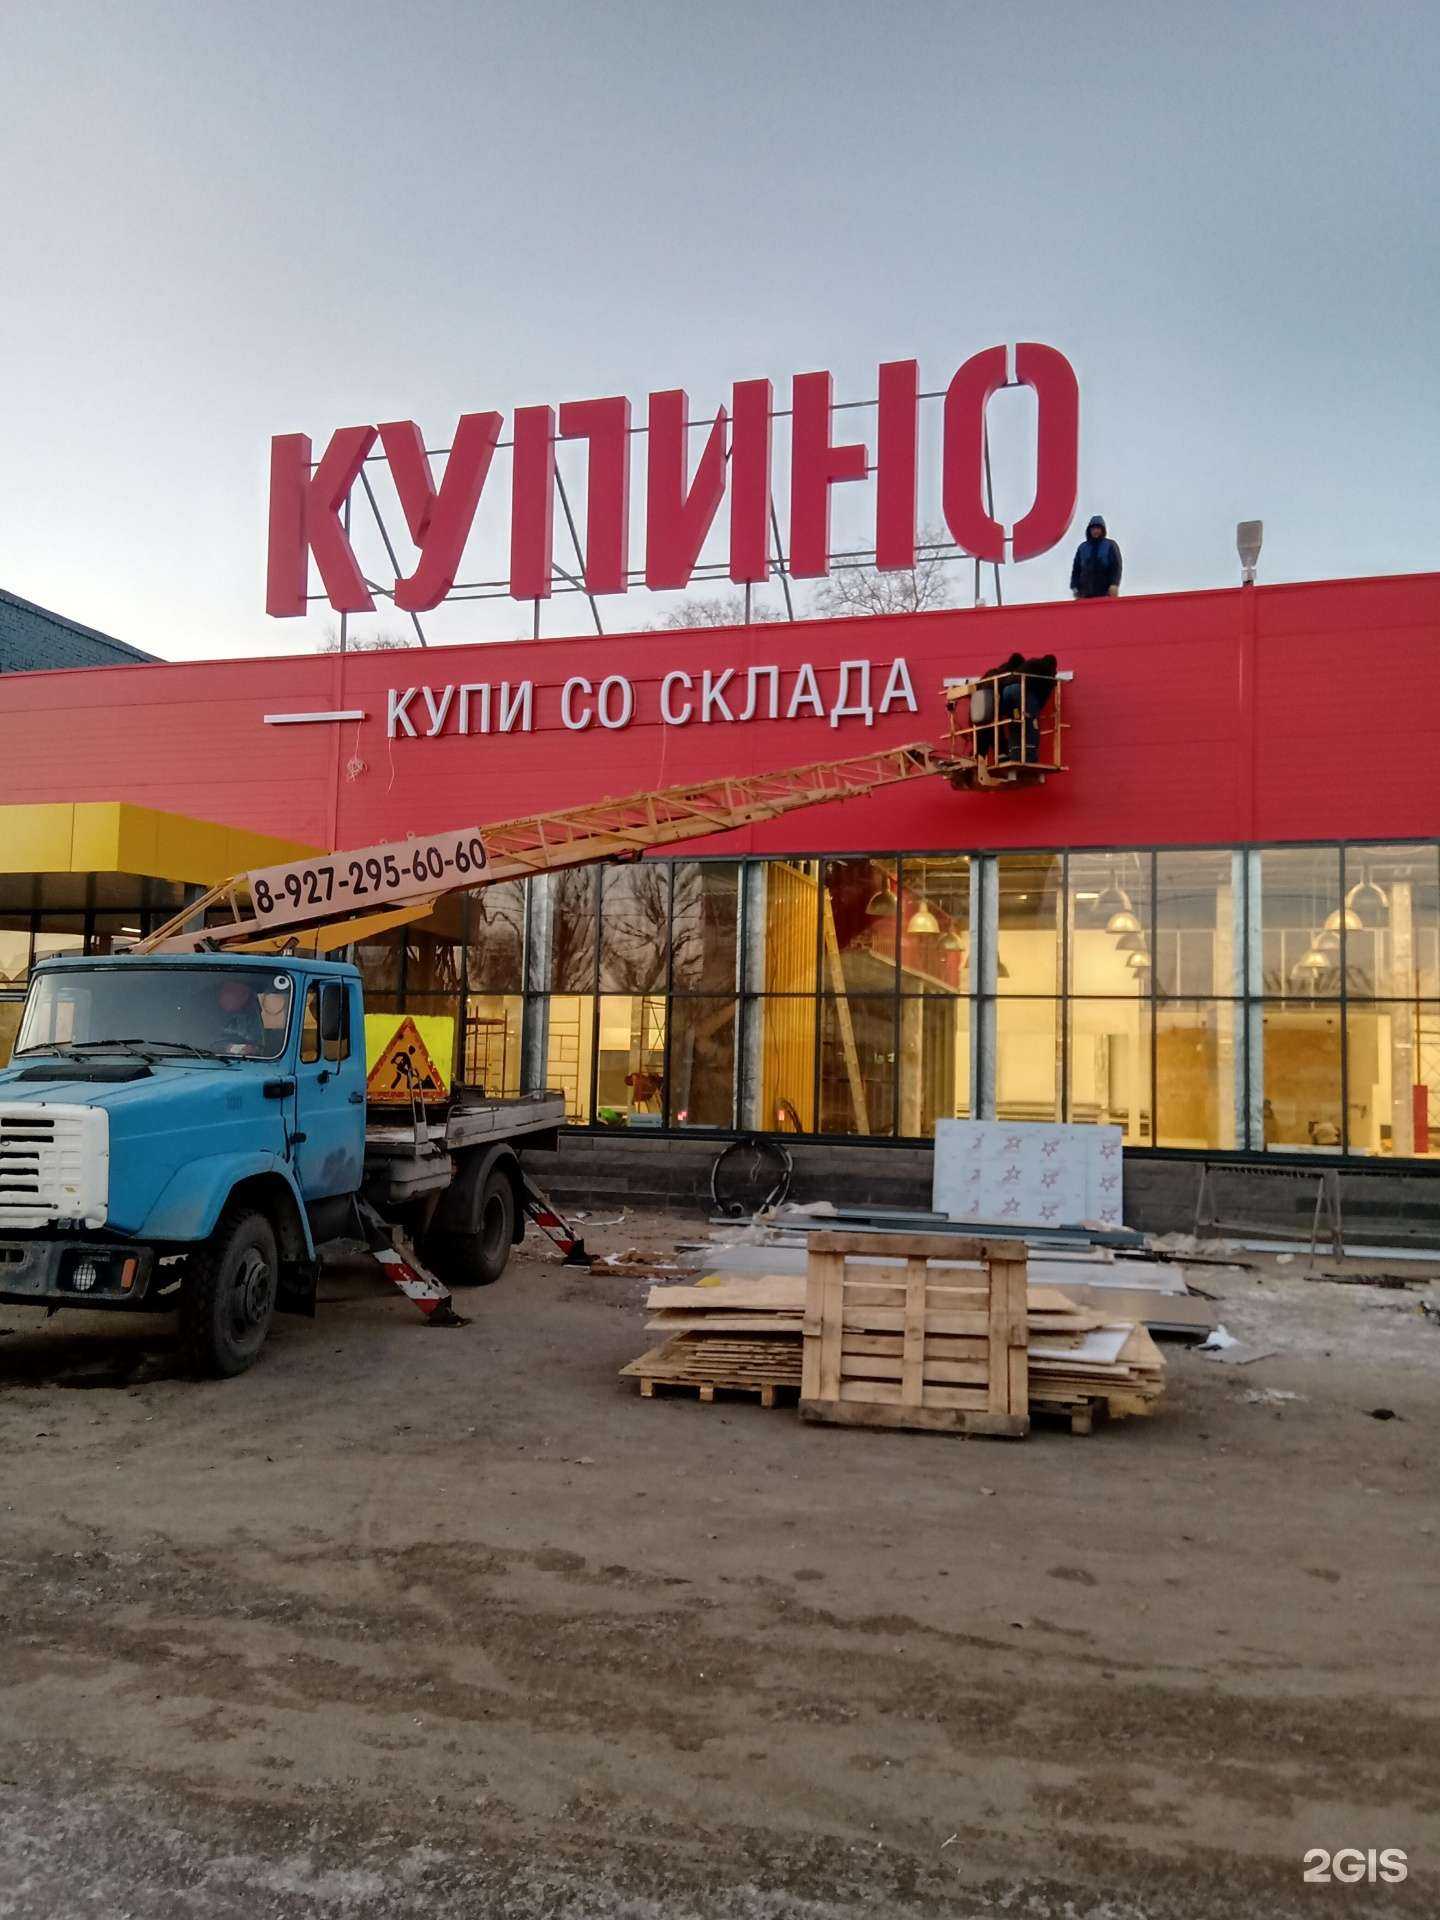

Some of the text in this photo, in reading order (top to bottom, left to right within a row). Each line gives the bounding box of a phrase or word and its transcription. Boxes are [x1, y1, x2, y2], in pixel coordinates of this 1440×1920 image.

[266, 343, 1079, 618] КУПИНО
[387, 658, 919, 738] КУПИ СО СКЛАДА
[254, 838, 487, 914] 8-927-295-60-60
